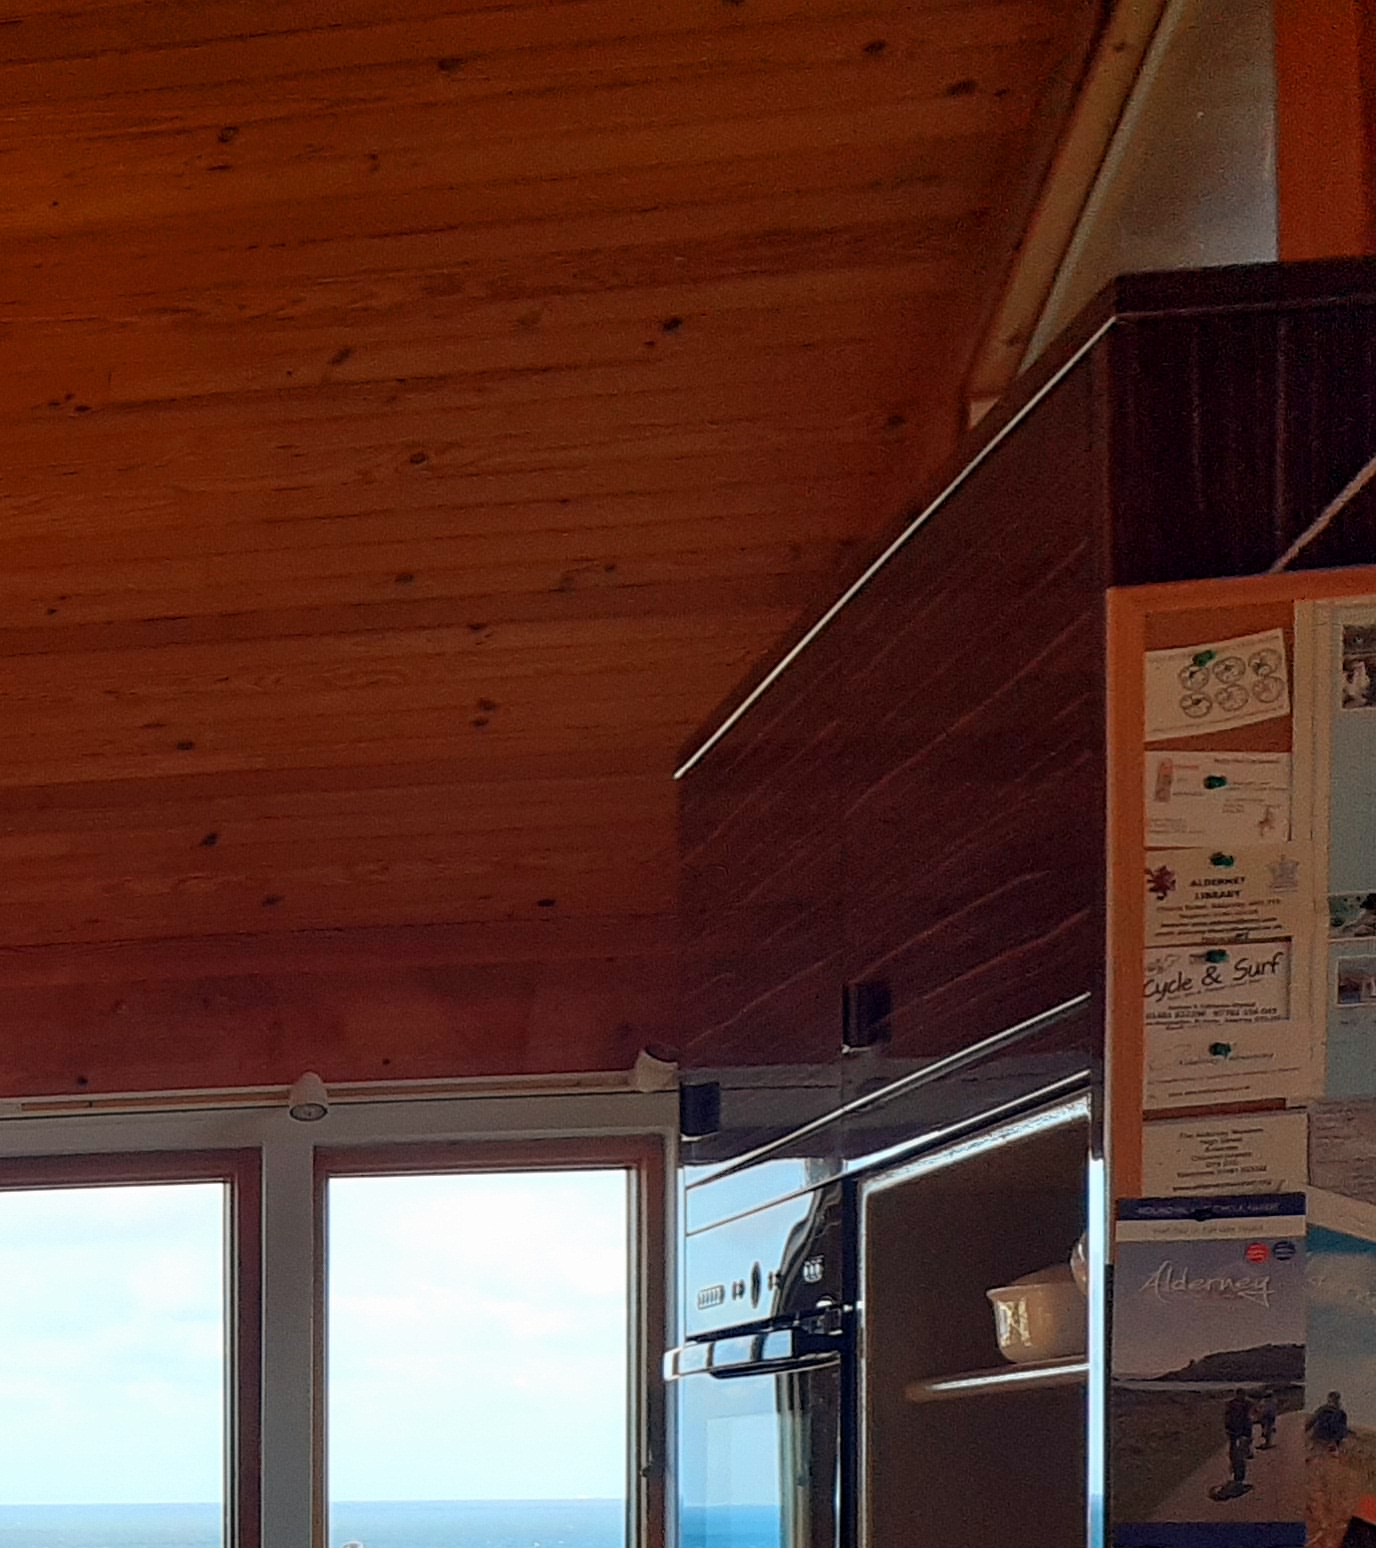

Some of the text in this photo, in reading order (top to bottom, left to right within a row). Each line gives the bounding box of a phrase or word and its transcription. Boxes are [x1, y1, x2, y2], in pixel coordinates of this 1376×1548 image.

[1190, 876, 1246, 887] ALDERNEY
[1194, 889, 1243, 900] LIBRARY
[1143, 971, 1193, 1003] Cycle
[1201, 965, 1223, 986] &
[1232, 951, 1284, 982] Surf
[1138, 1259, 1276, 1308] Alderney
